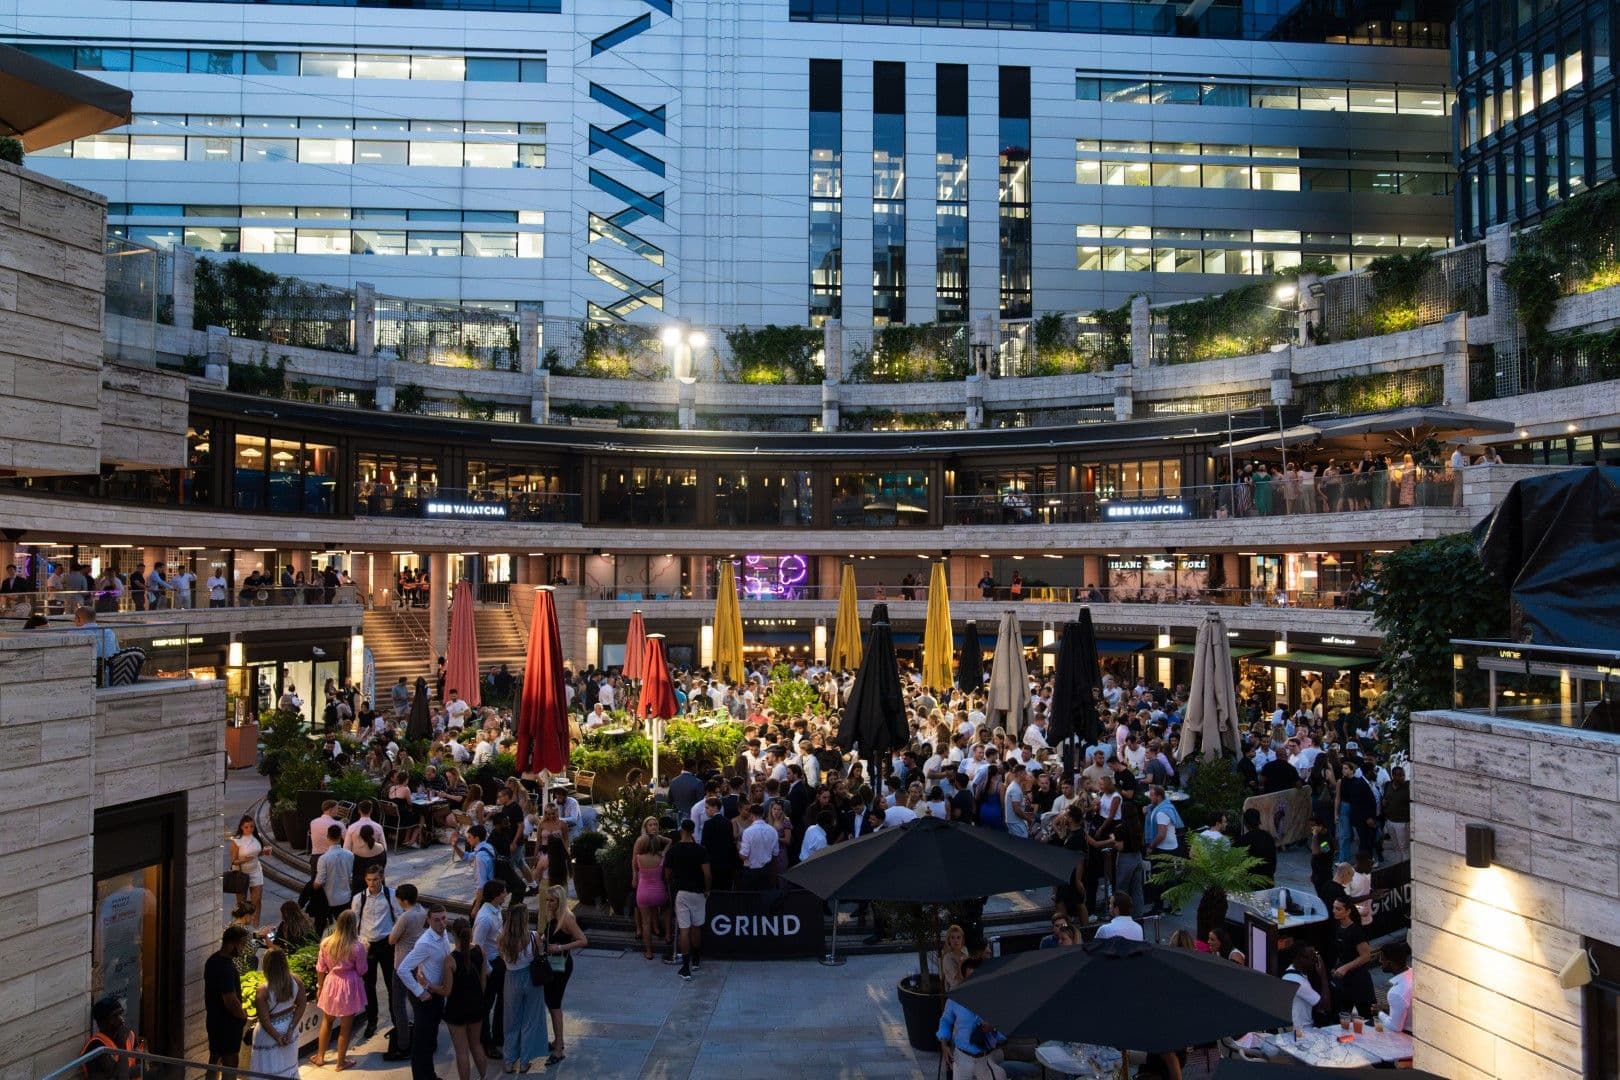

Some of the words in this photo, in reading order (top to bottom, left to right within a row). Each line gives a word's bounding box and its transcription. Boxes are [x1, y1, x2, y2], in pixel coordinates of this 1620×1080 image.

[454, 504, 505, 515] YAUATCHA
[1132, 505, 1184, 515] YAUATCHA
[710, 914, 801, 936] GRIND
